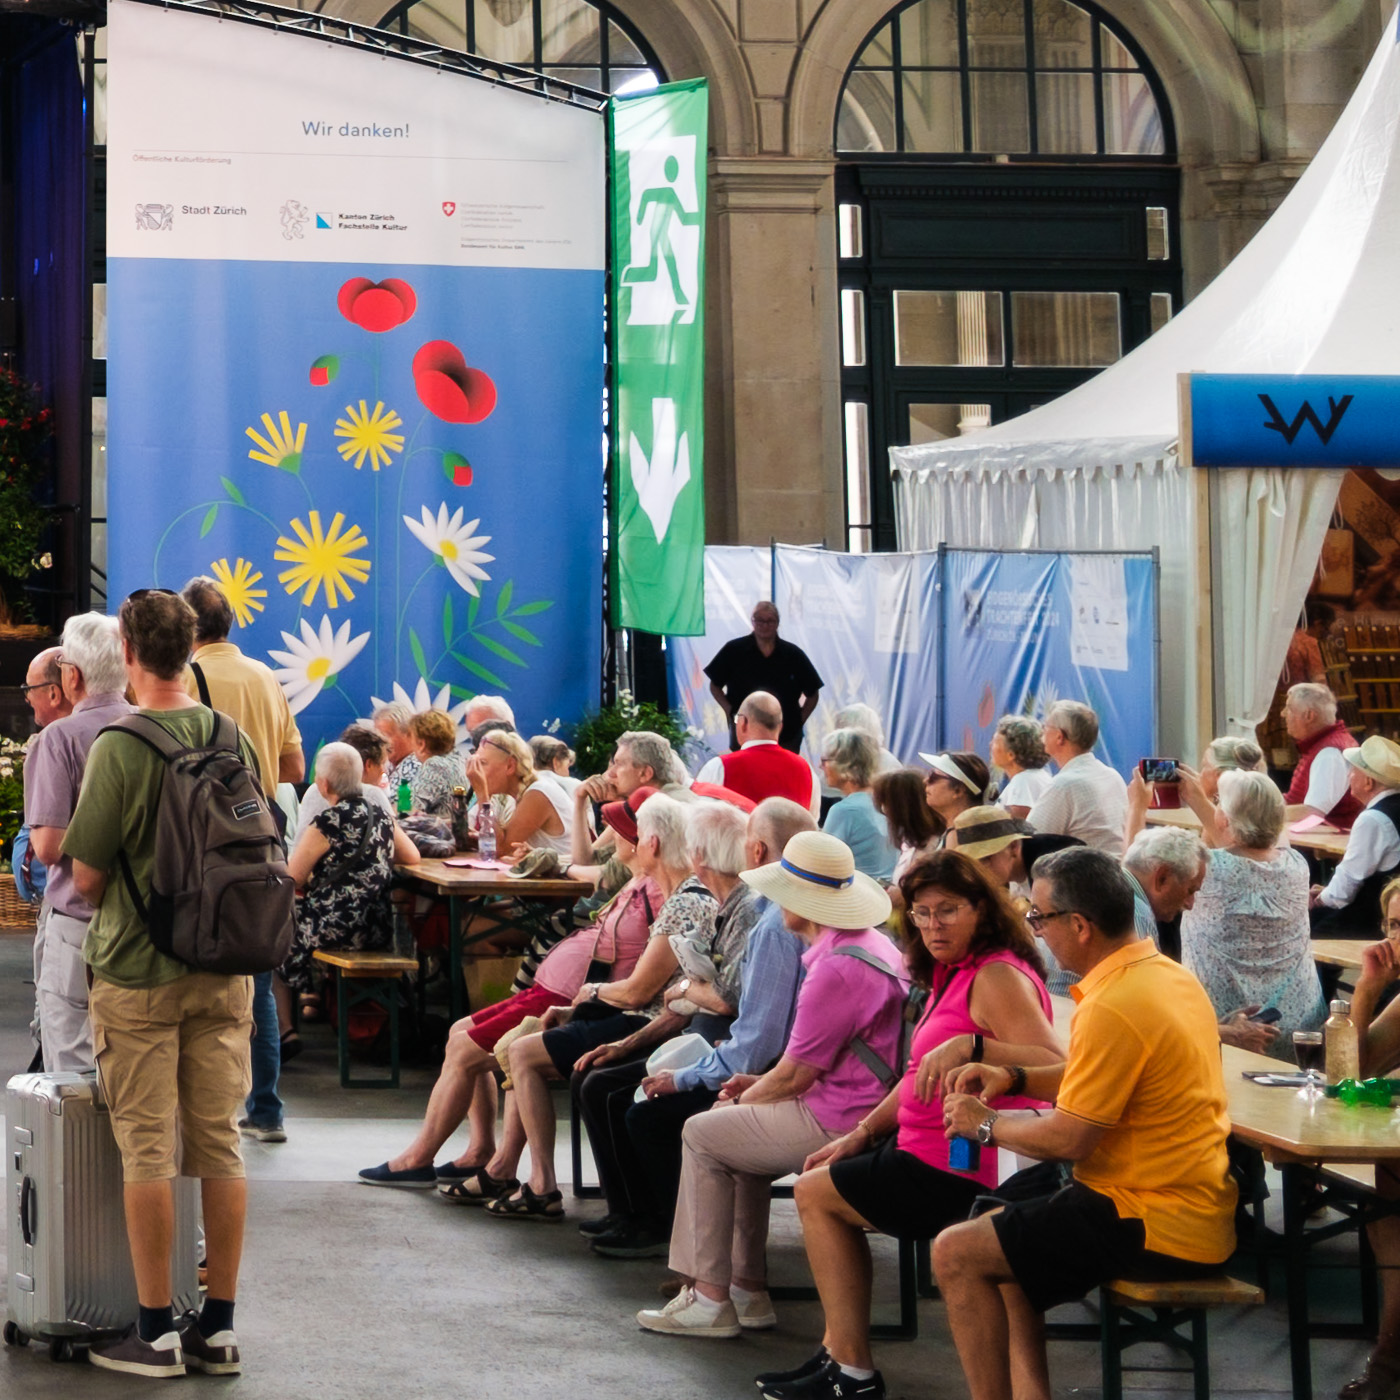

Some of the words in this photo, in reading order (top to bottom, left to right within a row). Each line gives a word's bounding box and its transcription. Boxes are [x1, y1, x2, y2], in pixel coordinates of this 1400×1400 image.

[302, 121, 333, 136] Wir
[338, 122, 410, 138] danken!
[181, 205, 210, 215] Stadt
[213, 205, 247, 215] Zürich
